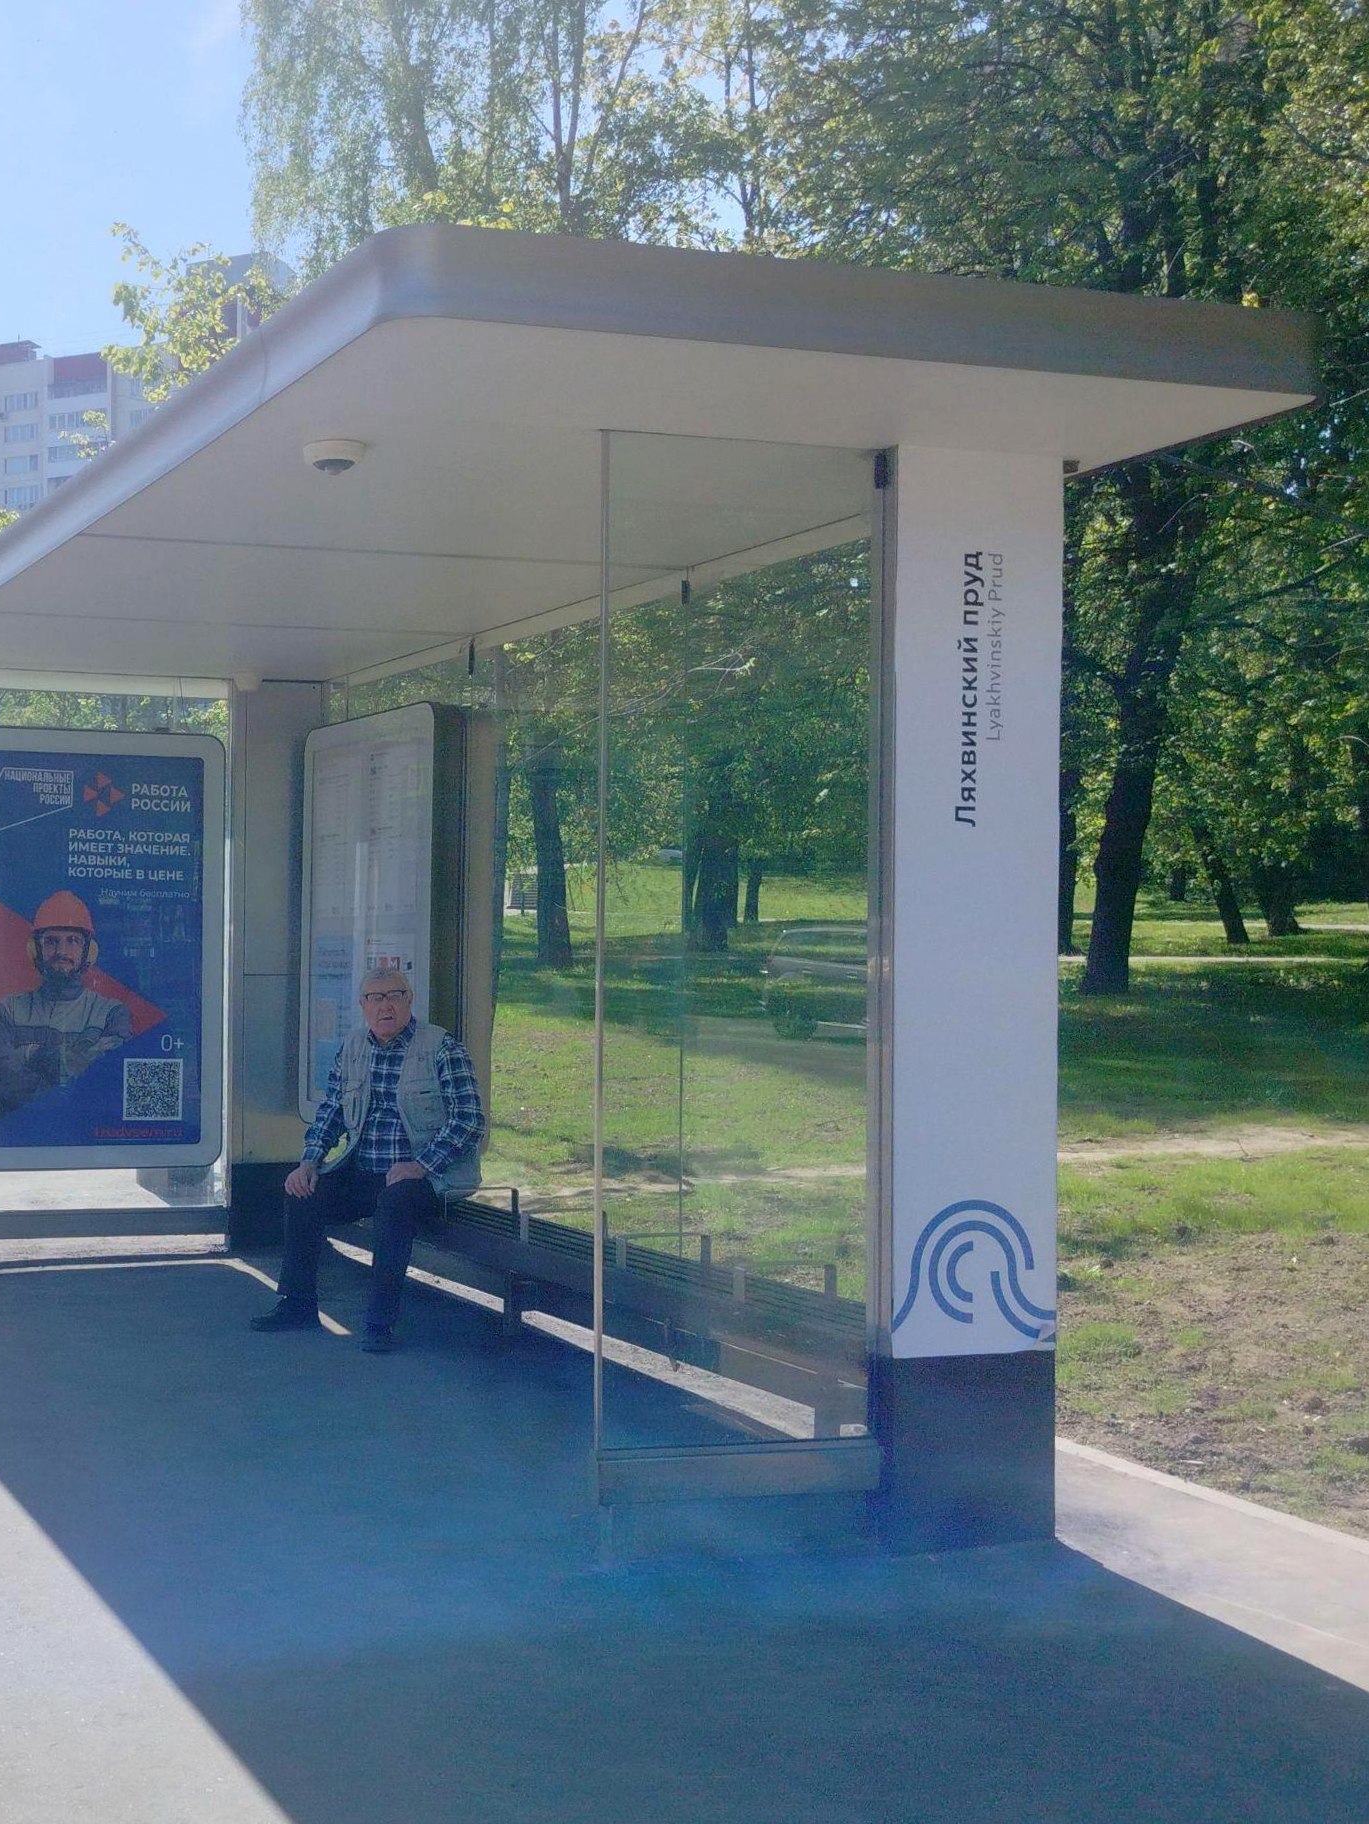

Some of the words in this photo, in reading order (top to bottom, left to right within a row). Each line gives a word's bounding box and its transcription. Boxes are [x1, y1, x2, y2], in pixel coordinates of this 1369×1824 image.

[987, 553, 1004, 601] Prud
[963, 551, 985, 626] пруд
[986, 607, 1005, 741] Lyakhvinskiy
[954, 637, 978, 828] Ляхвинский
[4, 770, 72, 784] НАЦИОНАЛЬНЫЕ
[33, 782, 72, 795] ПРОЕКТЫ
[131, 783, 189, 798] РАБОТА
[39, 793, 71, 806] РОССИИ
[131, 799, 191, 813] РОССИИ
[68, 828, 126, 842] РАБОТА,
[128, 831, 190, 844] КОТОРАЯ
[68, 842, 115, 853] ИМЕЕТ
[116, 843, 191, 856] ЗНАЧЕНИЕ.
[68, 855, 130, 868] НАВЫКИ,
[68, 867, 133, 880] КОТОРЫЕ
[136, 869, 145, 880] В
[148, 870, 184, 882] ЦЕНЕ
[139, 888, 191, 899] бесплатно
[161, 1034, 184, 1052] 0+
